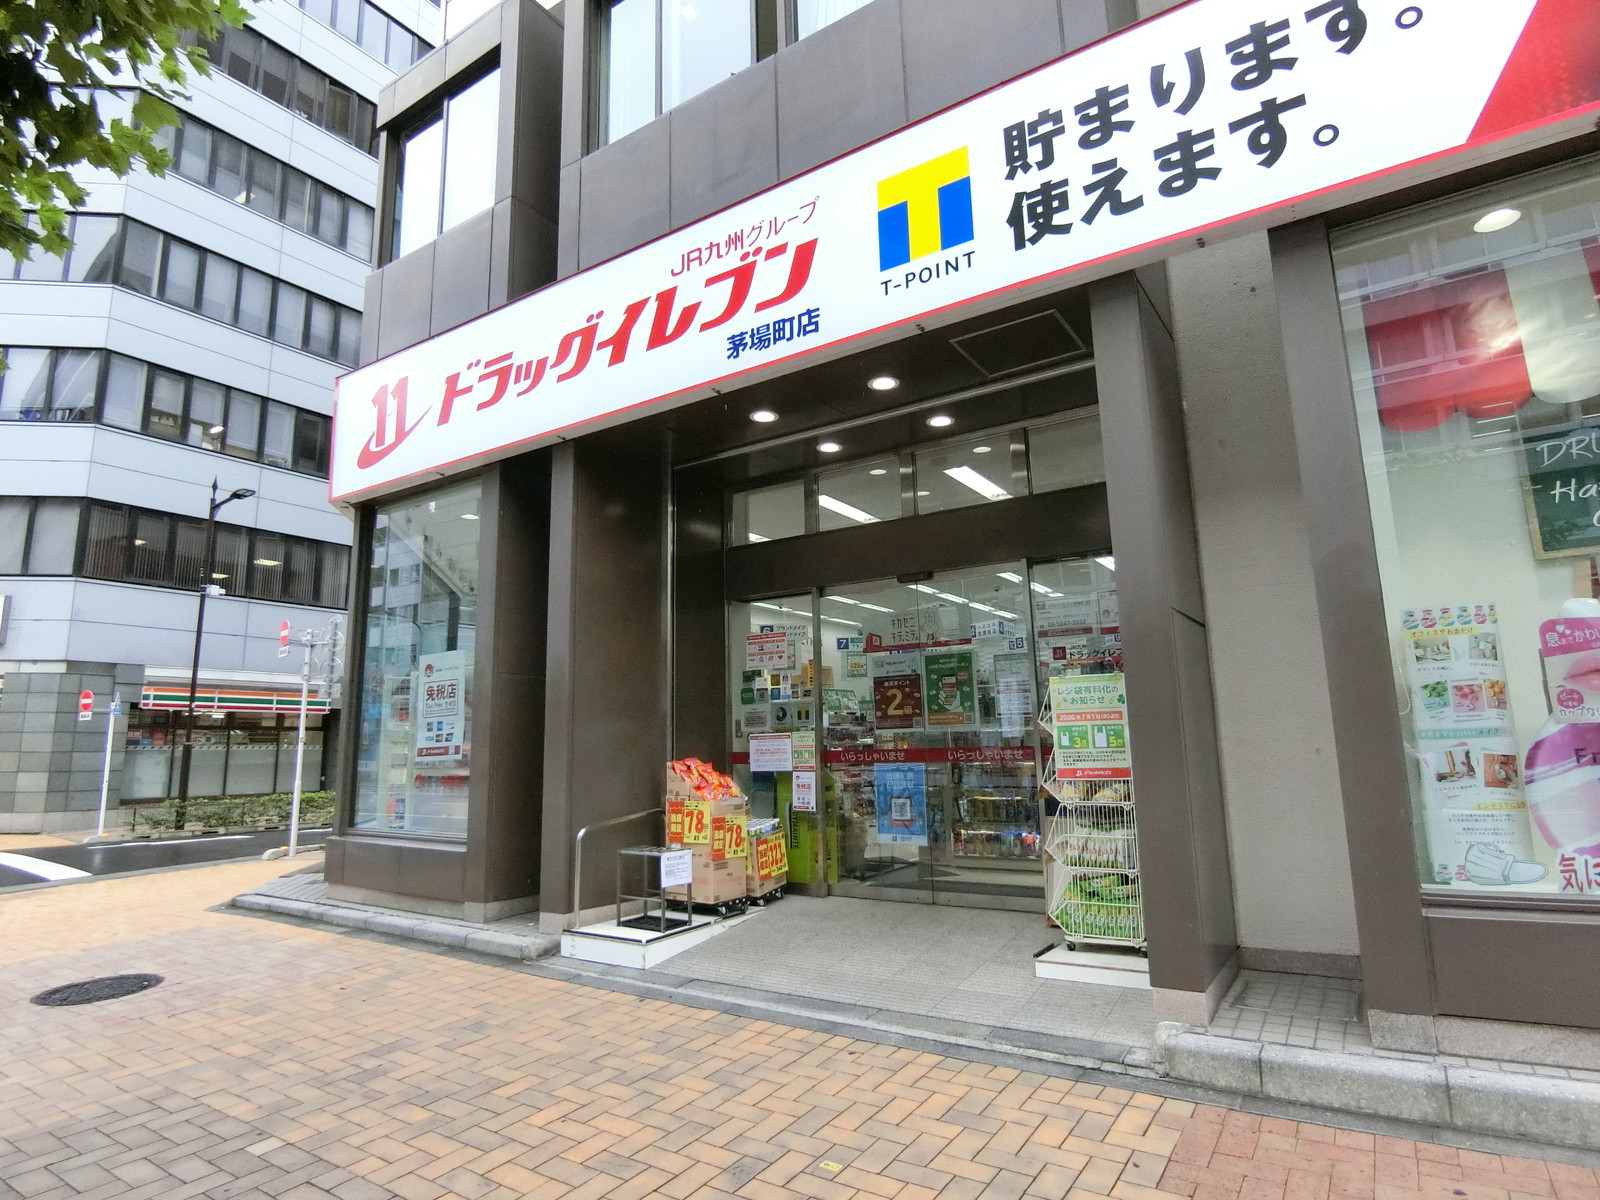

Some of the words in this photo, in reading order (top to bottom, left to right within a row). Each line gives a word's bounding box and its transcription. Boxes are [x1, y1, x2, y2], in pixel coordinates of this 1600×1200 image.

[1003, 0, 1424, 181] 貯まります。
[1004, 93, 1340, 251] 使えます。
[671, 195, 821, 277] JR九州グループ
[879, 250, 977, 297] T-POINT
[437, 237, 819, 427] ドラッグイレブン
[726, 307, 821, 360] 茅場町店
[1550, 478, 1600, 504] Ha
[839, 640, 847, 649] 7
[425, 683, 457, 702] 免税店
[1057, 685, 1119, 695] レジ袋有料化の
[1070, 695, 1106, 705] お知らせ
[840, 751, 906, 762] いらっしゃいませ
[948, 749, 1024, 760] いらっしゃいませ
[685, 810, 704, 834] 78
[726, 824, 743, 849] 78
